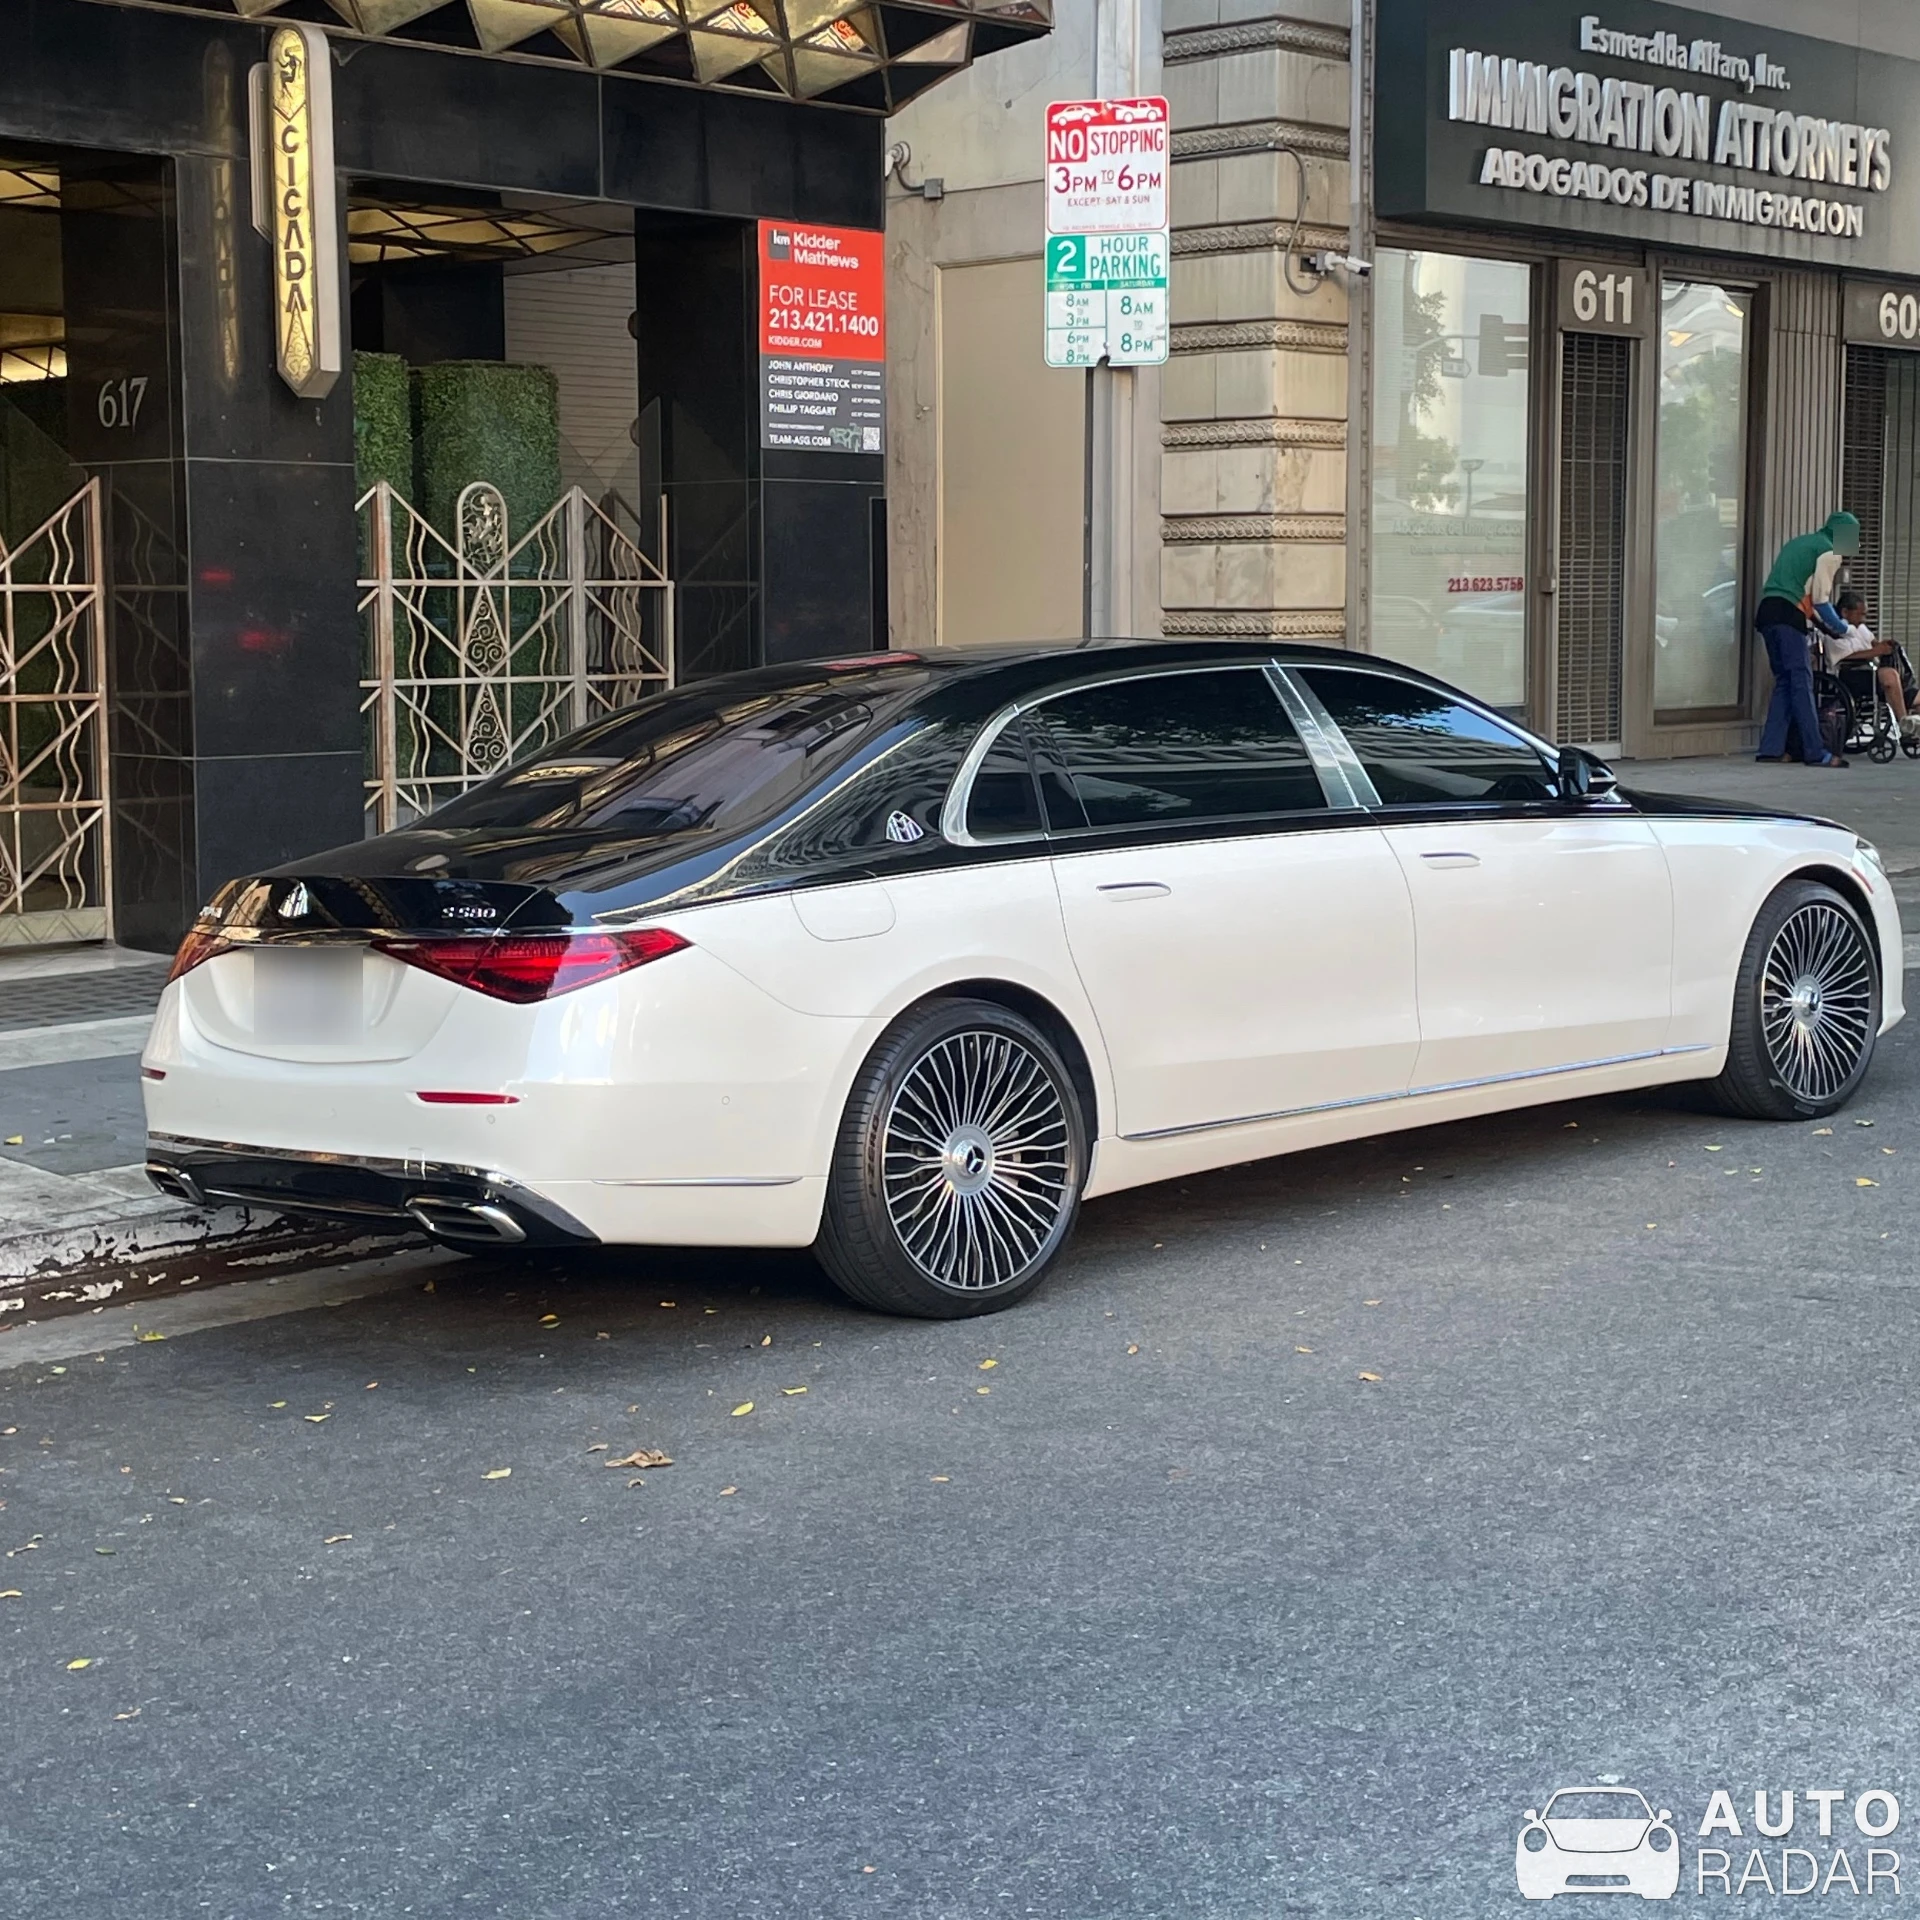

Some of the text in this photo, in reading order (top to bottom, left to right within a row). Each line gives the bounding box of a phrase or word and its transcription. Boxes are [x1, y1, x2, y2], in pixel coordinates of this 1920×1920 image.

[1581, 15, 1791, 94] Esmeralda Alfaro, Inc.
[1449, 48, 1891, 192] IMMIGRATION ATTORNEYS
[1050, 128, 1163, 160] NO STOPPING
[1101, 169, 1114, 183] TO
[1068, 197, 1100, 207] EXCEPT
[1106, 196, 1122, 205] SAT
[1132, 195, 1150, 204] SUN
[1480, 147, 1863, 237] ABOGADOS DE INMIGRACION
[281, 124, 308, 313] CICADA
[773, 229, 790, 245] km
[793, 232, 840, 251] Kidder
[1101, 236, 1148, 253] HOUR
[794, 248, 859, 269] Mathews
[1057, 240, 1077, 273] 2
[1090, 253, 1160, 279] PARKING
[769, 285, 857, 311] FOR LEASE
[1573, 269, 1632, 324] 611
[769, 308, 879, 336] 213.421.1400
[1880, 292, 1920, 339] 60
[768, 335, 822, 348] KIDDER.COM
[768, 360, 834, 373] JOHN ANTHONY
[768, 374, 824, 387] CHRISTOPHER
[98, 376, 148, 432] 617
[768, 389, 793, 399] CHRIS
[794, 390, 839, 402] GIORDANO
[769, 403, 837, 416] PHILLIP TAGGART
